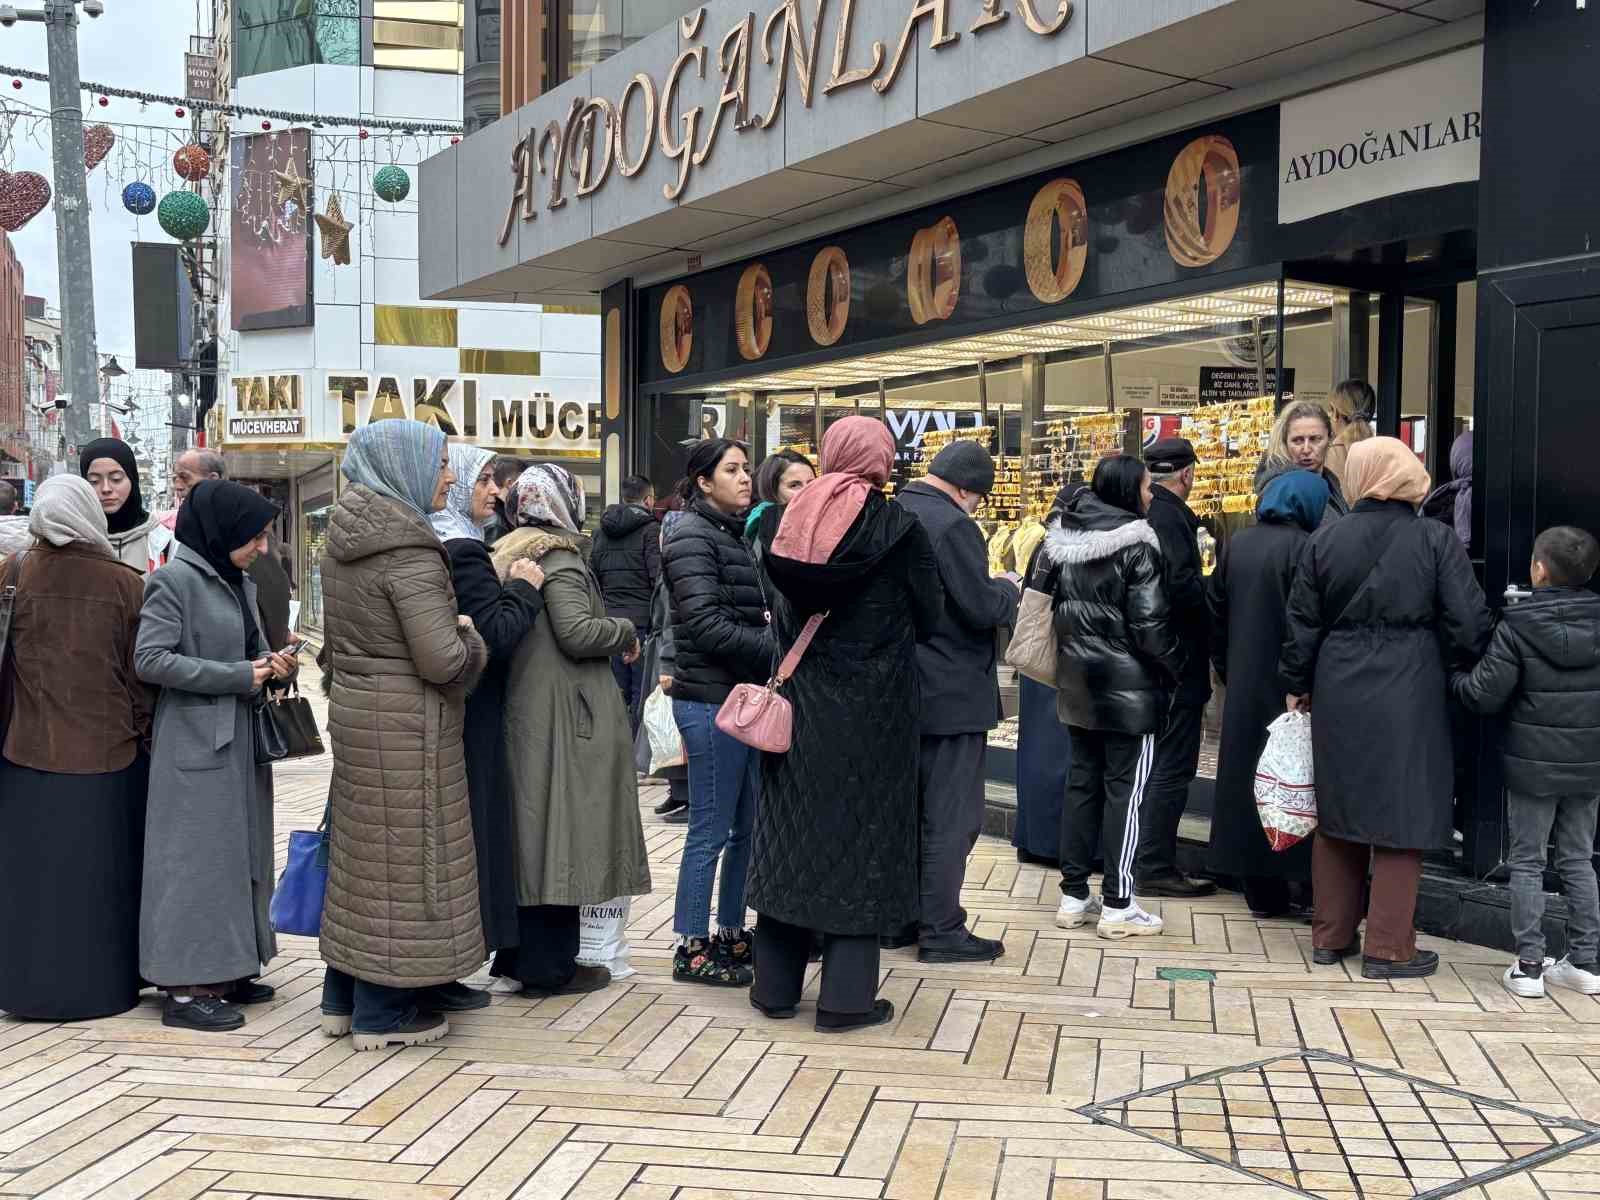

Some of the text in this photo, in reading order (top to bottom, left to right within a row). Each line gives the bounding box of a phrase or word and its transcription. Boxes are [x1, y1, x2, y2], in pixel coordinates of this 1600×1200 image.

[498, 0, 1074, 245] AYDOĞANLA
[1284, 111, 1481, 183] AYDOĞANLAR
[231, 375, 300, 412] TAKI
[328, 376, 477, 436] TAKI
[231, 418, 300, 435] MÜCEVHERAT
